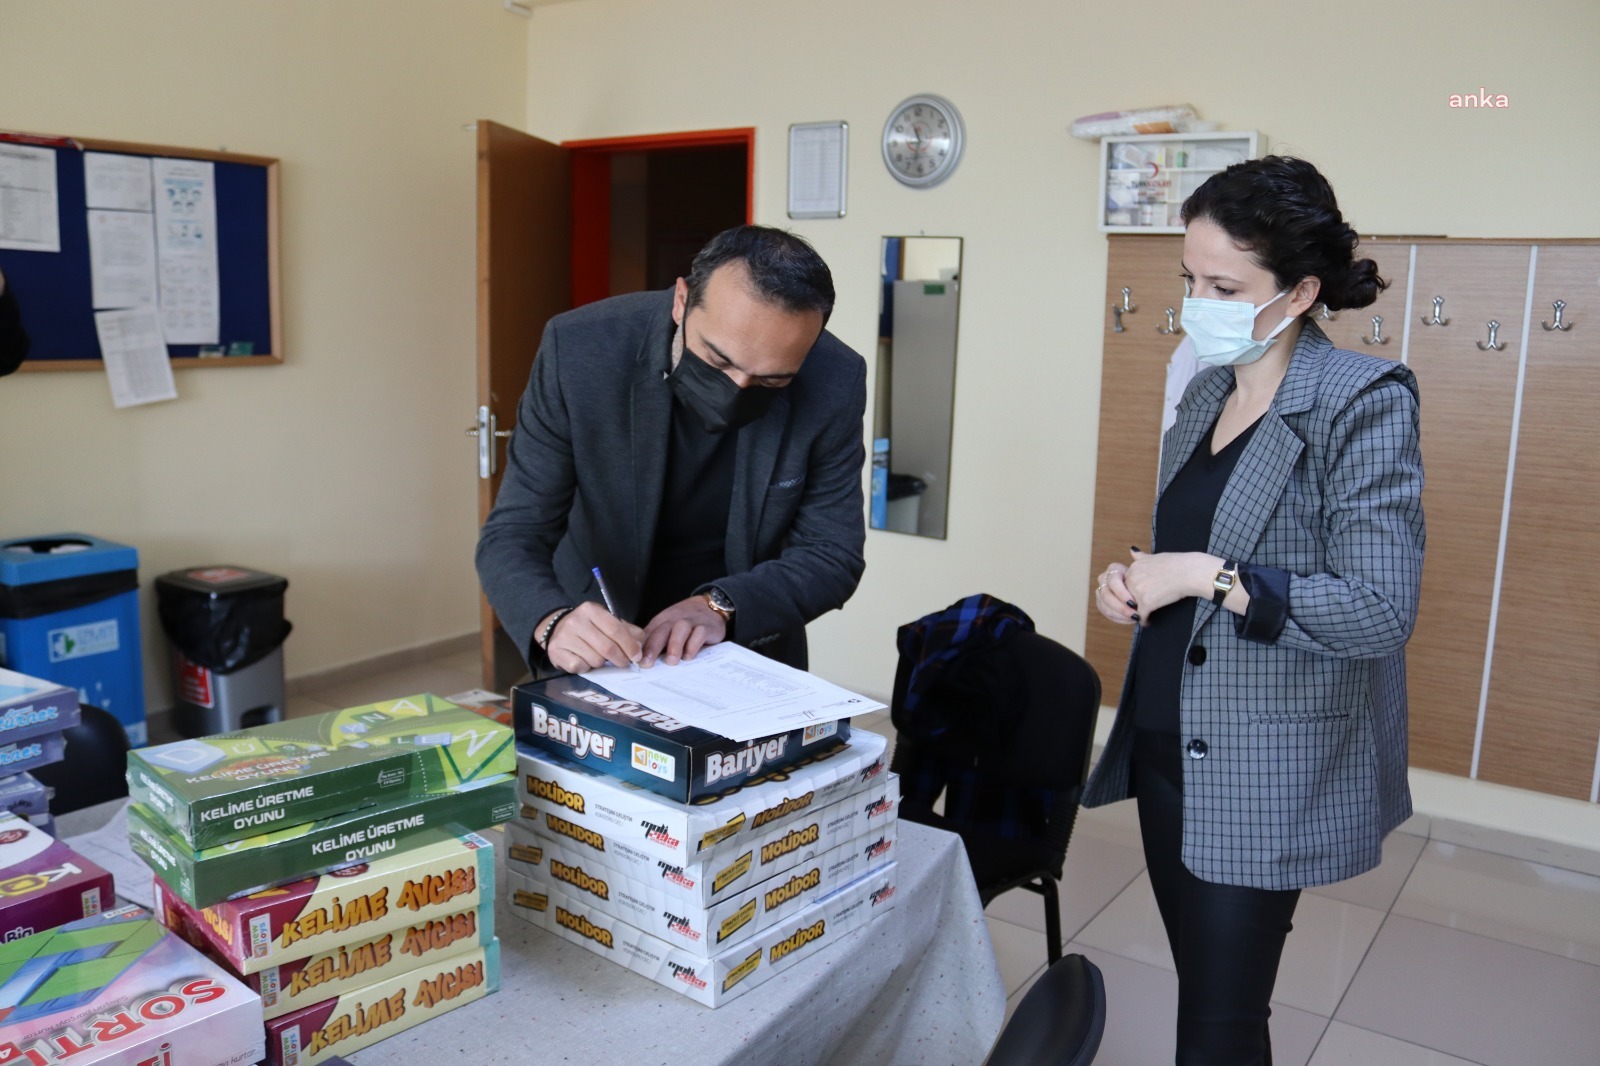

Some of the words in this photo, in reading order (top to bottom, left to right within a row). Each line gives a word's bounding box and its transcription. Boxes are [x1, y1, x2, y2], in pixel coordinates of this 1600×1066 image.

[532, 703, 616, 762] Bariyer
[648, 750, 668, 763] new
[648, 760, 668, 775] toys
[705, 733, 788, 786] Bariyer
[200, 803, 254, 823] KELİME
[255, 786, 315, 809] ÜRETME
[526, 774, 586, 815] MOLİDOR
[233, 809, 286, 831] OYUNU
[311, 832, 366, 856] KELİME
[366, 814, 425, 840] ÜRETME
[344, 838, 397, 863] OYUNU
[760, 823, 819, 866] MOLİDOR
[550, 857, 610, 900] MOLİDOR
[764, 867, 821, 914] MOLİDOR
[281, 887, 389, 949] KELİME
[396, 866, 477, 912] AVCISI
[555, 905, 615, 950] MOLİDOR
[290, 933, 393, 998] KELİME
[400, 910, 477, 956] AVCISI
[769, 919, 826, 965] MOLİDOR
[309, 987, 407, 1057] KELİME
[412, 960, 485, 1008] AVCISI
